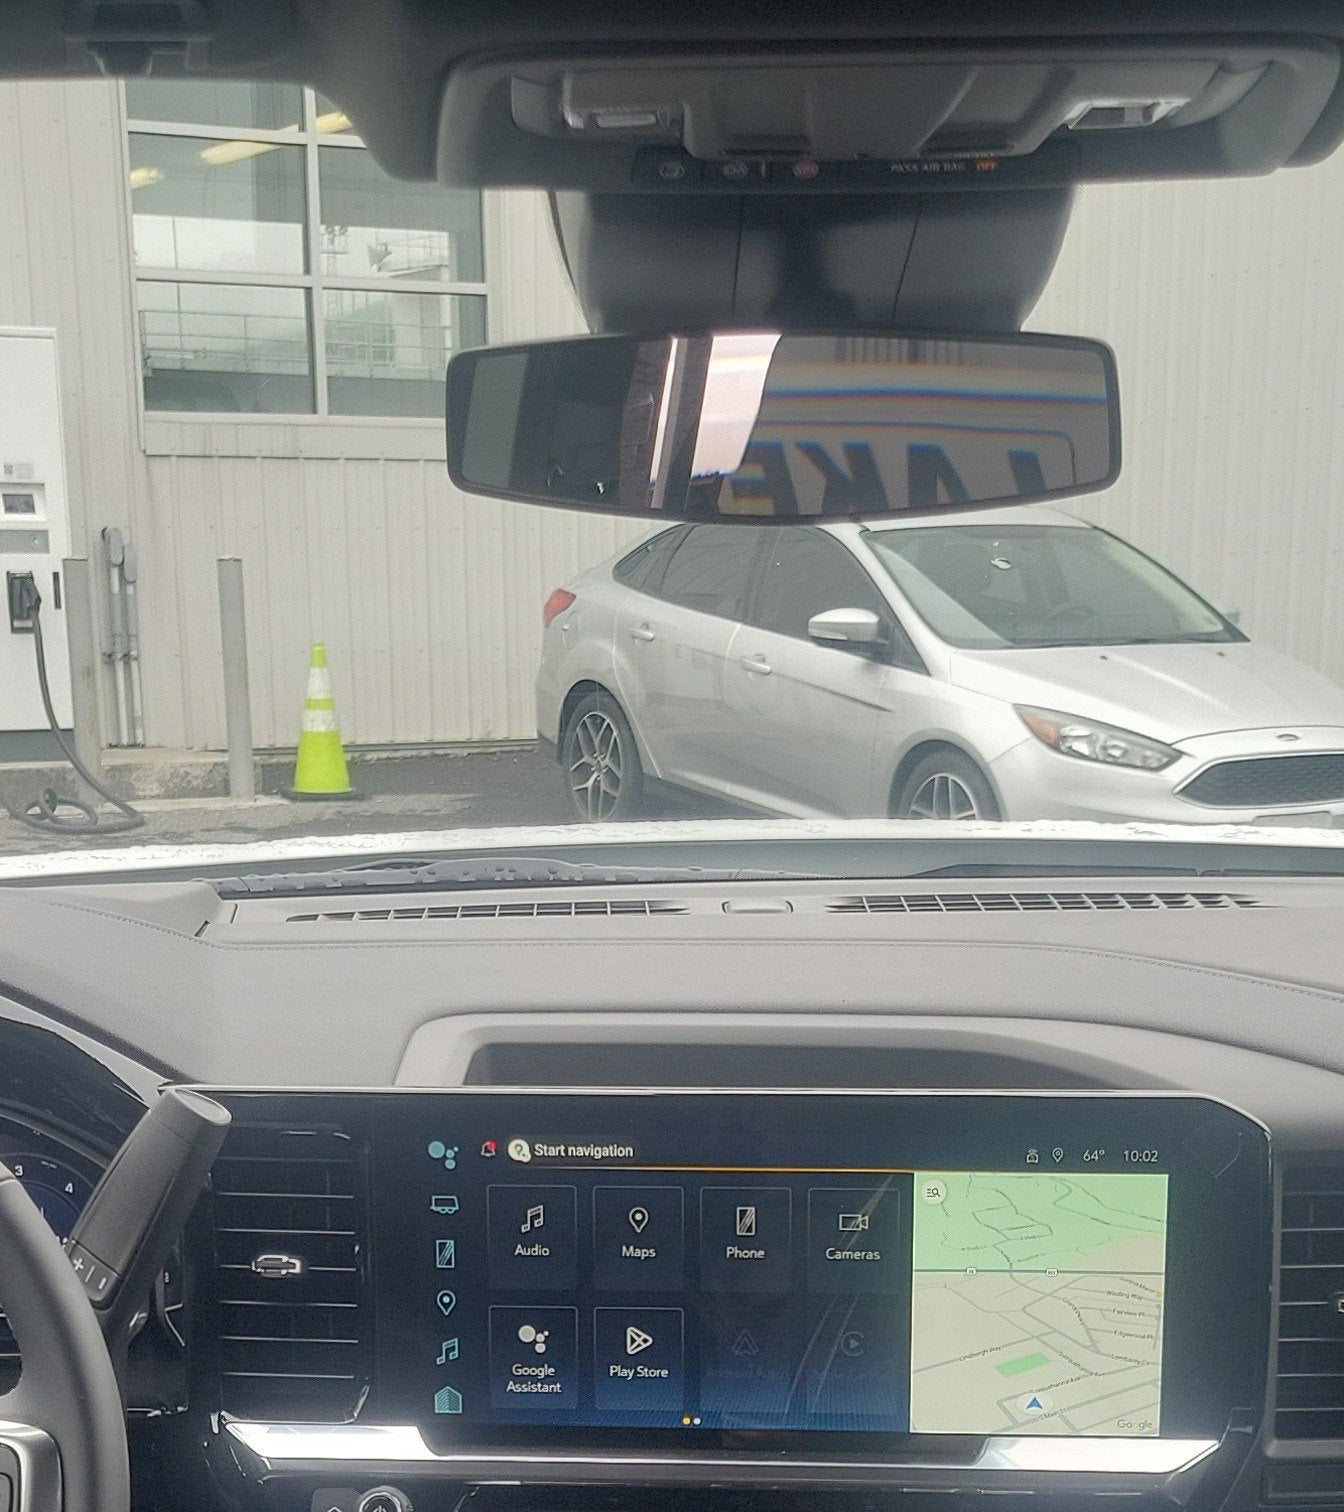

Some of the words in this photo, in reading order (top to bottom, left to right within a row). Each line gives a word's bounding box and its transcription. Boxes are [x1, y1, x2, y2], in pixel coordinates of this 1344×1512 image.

[534, 1143, 565, 1157] Start
[567, 1143, 634, 1158] navigation
[1082, 1149, 1106, 1162] 64°
[1123, 1150, 1158, 1163] 10:02
[14, 1165, 23, 1177] 3
[64, 1182, 74, 1194] 4
[514, 1244, 550, 1256] Audio
[621, 1245, 656, 1260] Maps
[726, 1246, 765, 1259] Phone
[825, 1248, 881, 1260] Cameras
[511, 1364, 556, 1378] Google
[609, 1365, 635, 1380] Play
[636, 1366, 669, 1378] Store
[506, 1381, 562, 1393] Assistant
